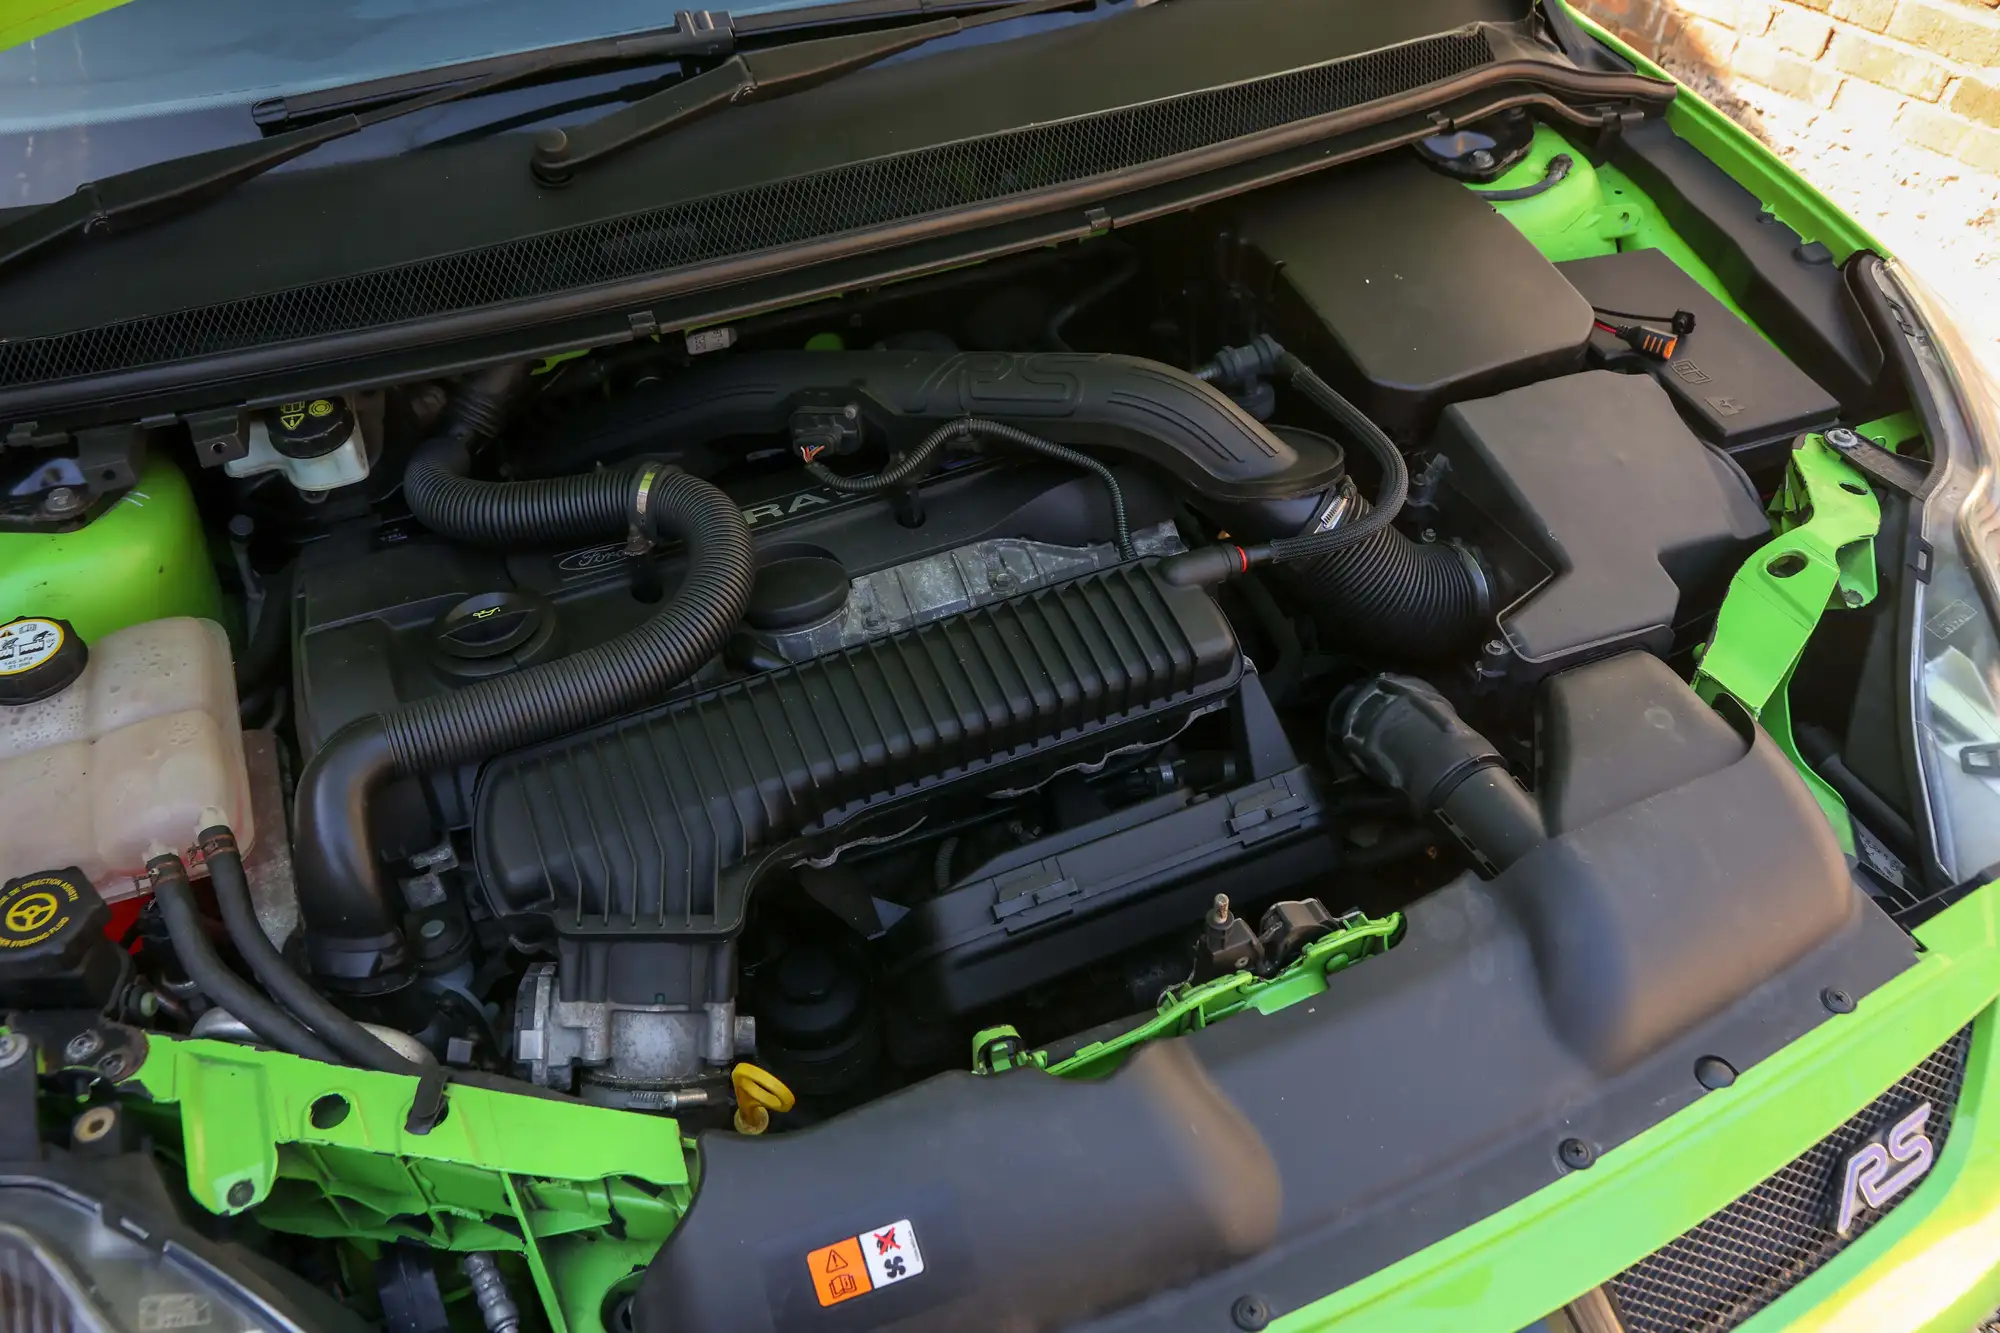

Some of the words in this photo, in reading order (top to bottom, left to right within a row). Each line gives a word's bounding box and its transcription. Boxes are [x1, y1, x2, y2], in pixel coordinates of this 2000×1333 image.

[22, 878, 63, 890] DIRECTION
[10, 932, 50, 948] STEERING
[49, 917, 69, 934] FLUID
[1837, 1101, 1934, 1236] RS
